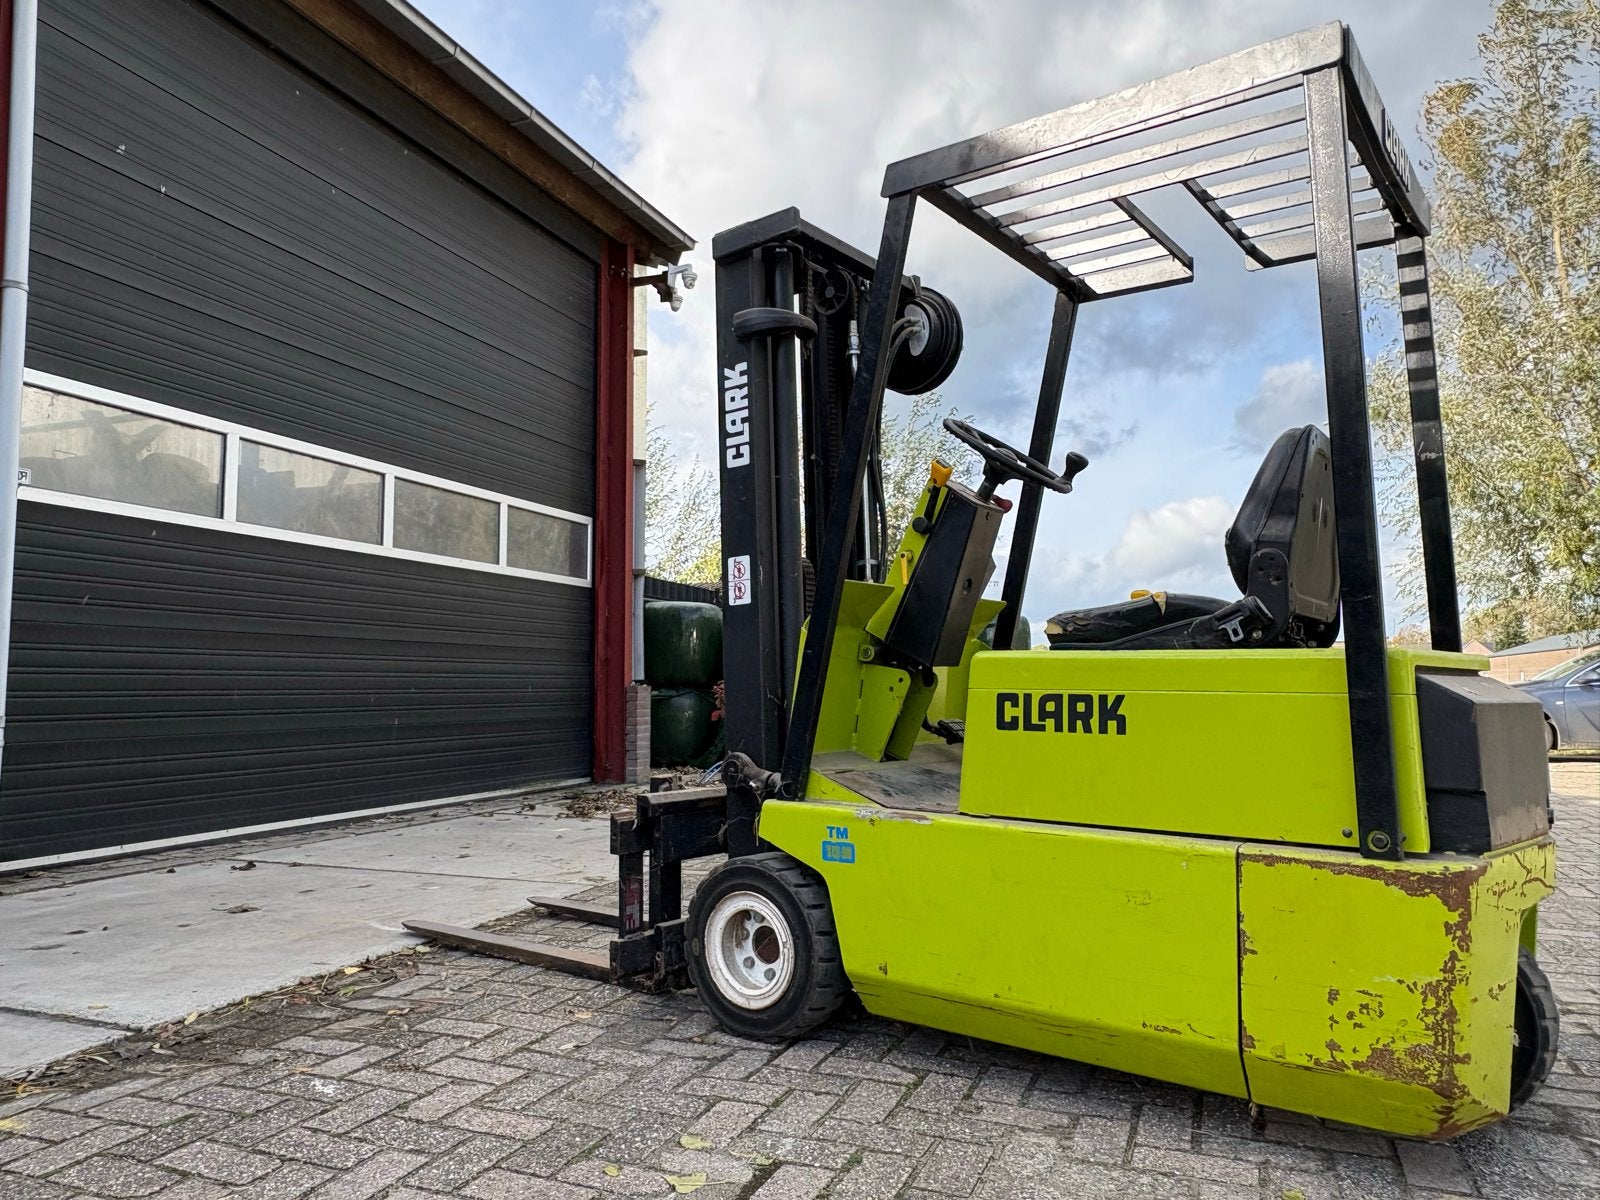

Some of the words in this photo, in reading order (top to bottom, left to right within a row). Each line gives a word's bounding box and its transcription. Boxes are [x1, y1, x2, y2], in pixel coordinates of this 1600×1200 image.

[724, 361, 751, 469] CLARK
[996, 692, 1127, 735] CLARK
[826, 825, 849, 840] TM
